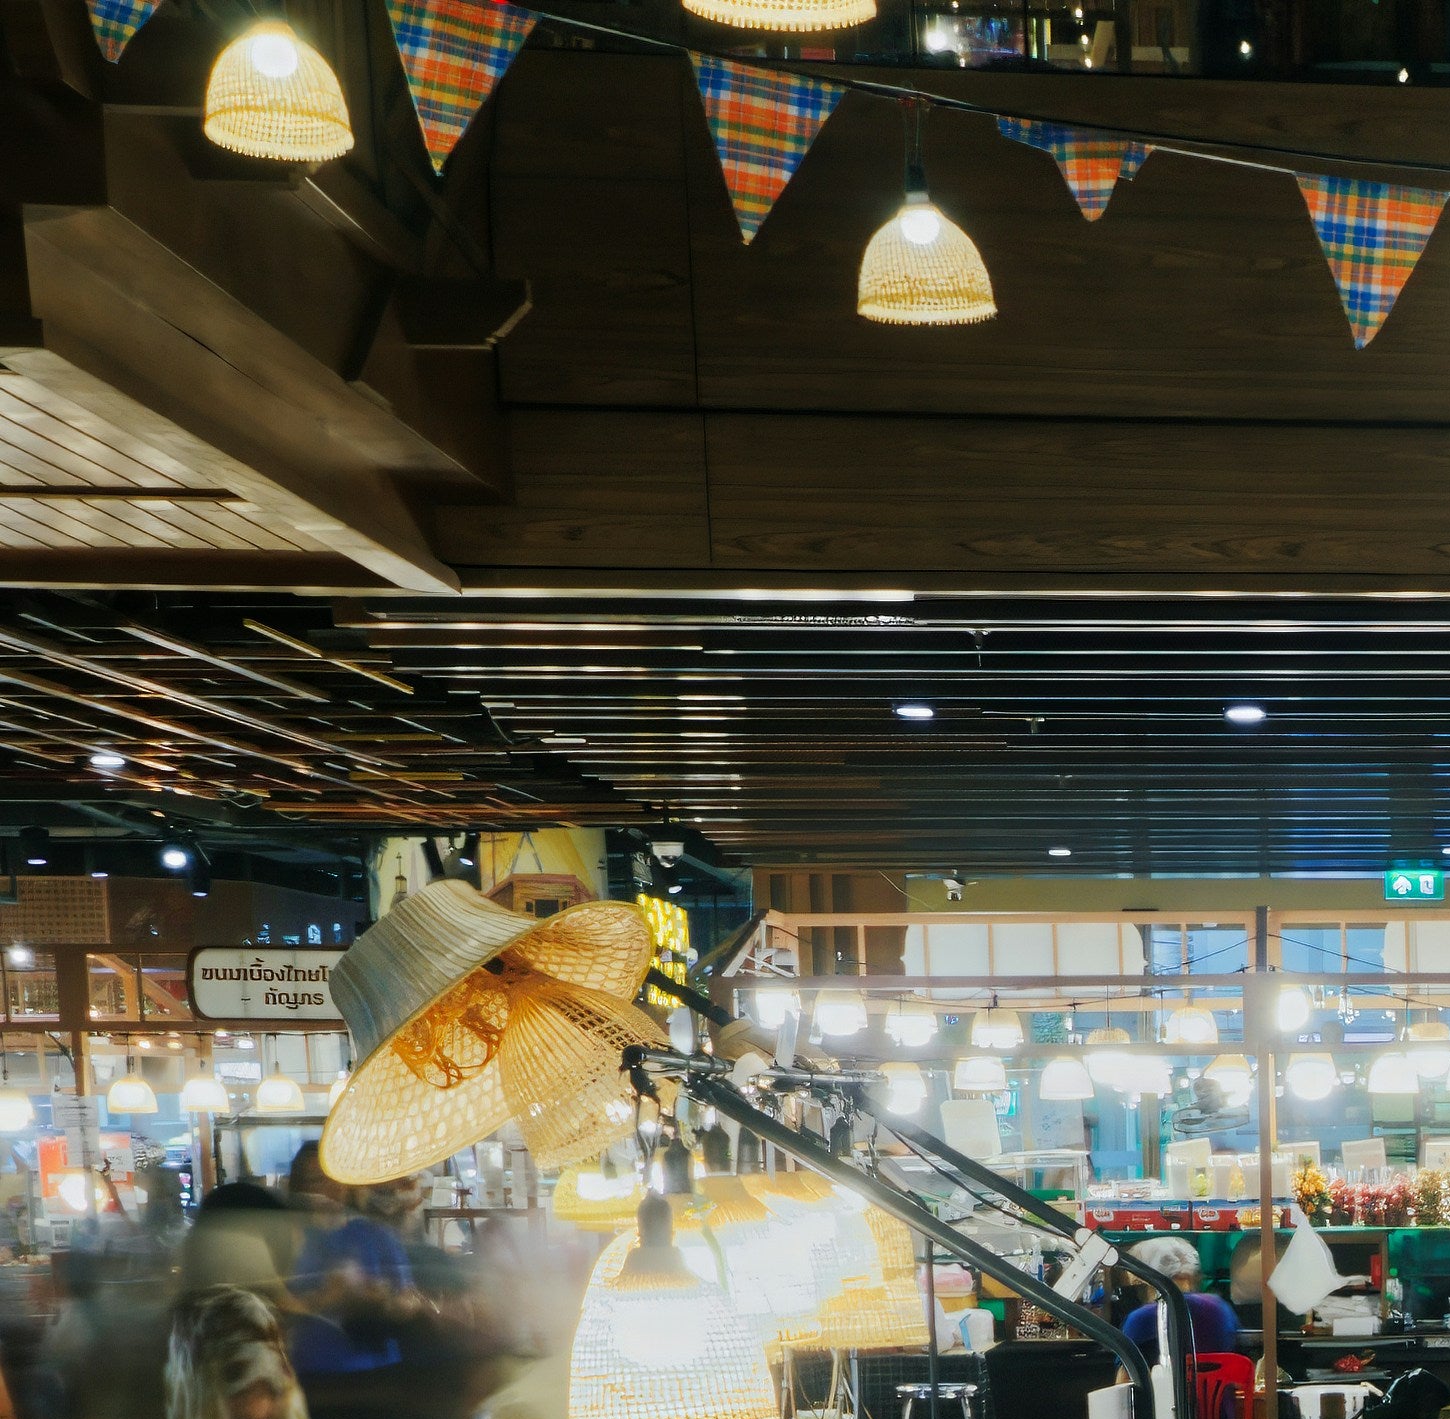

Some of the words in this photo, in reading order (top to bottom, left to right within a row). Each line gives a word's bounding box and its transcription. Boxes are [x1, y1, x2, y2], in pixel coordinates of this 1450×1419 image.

[201, 957, 330, 982] ขนมเบื้องไทยโ
